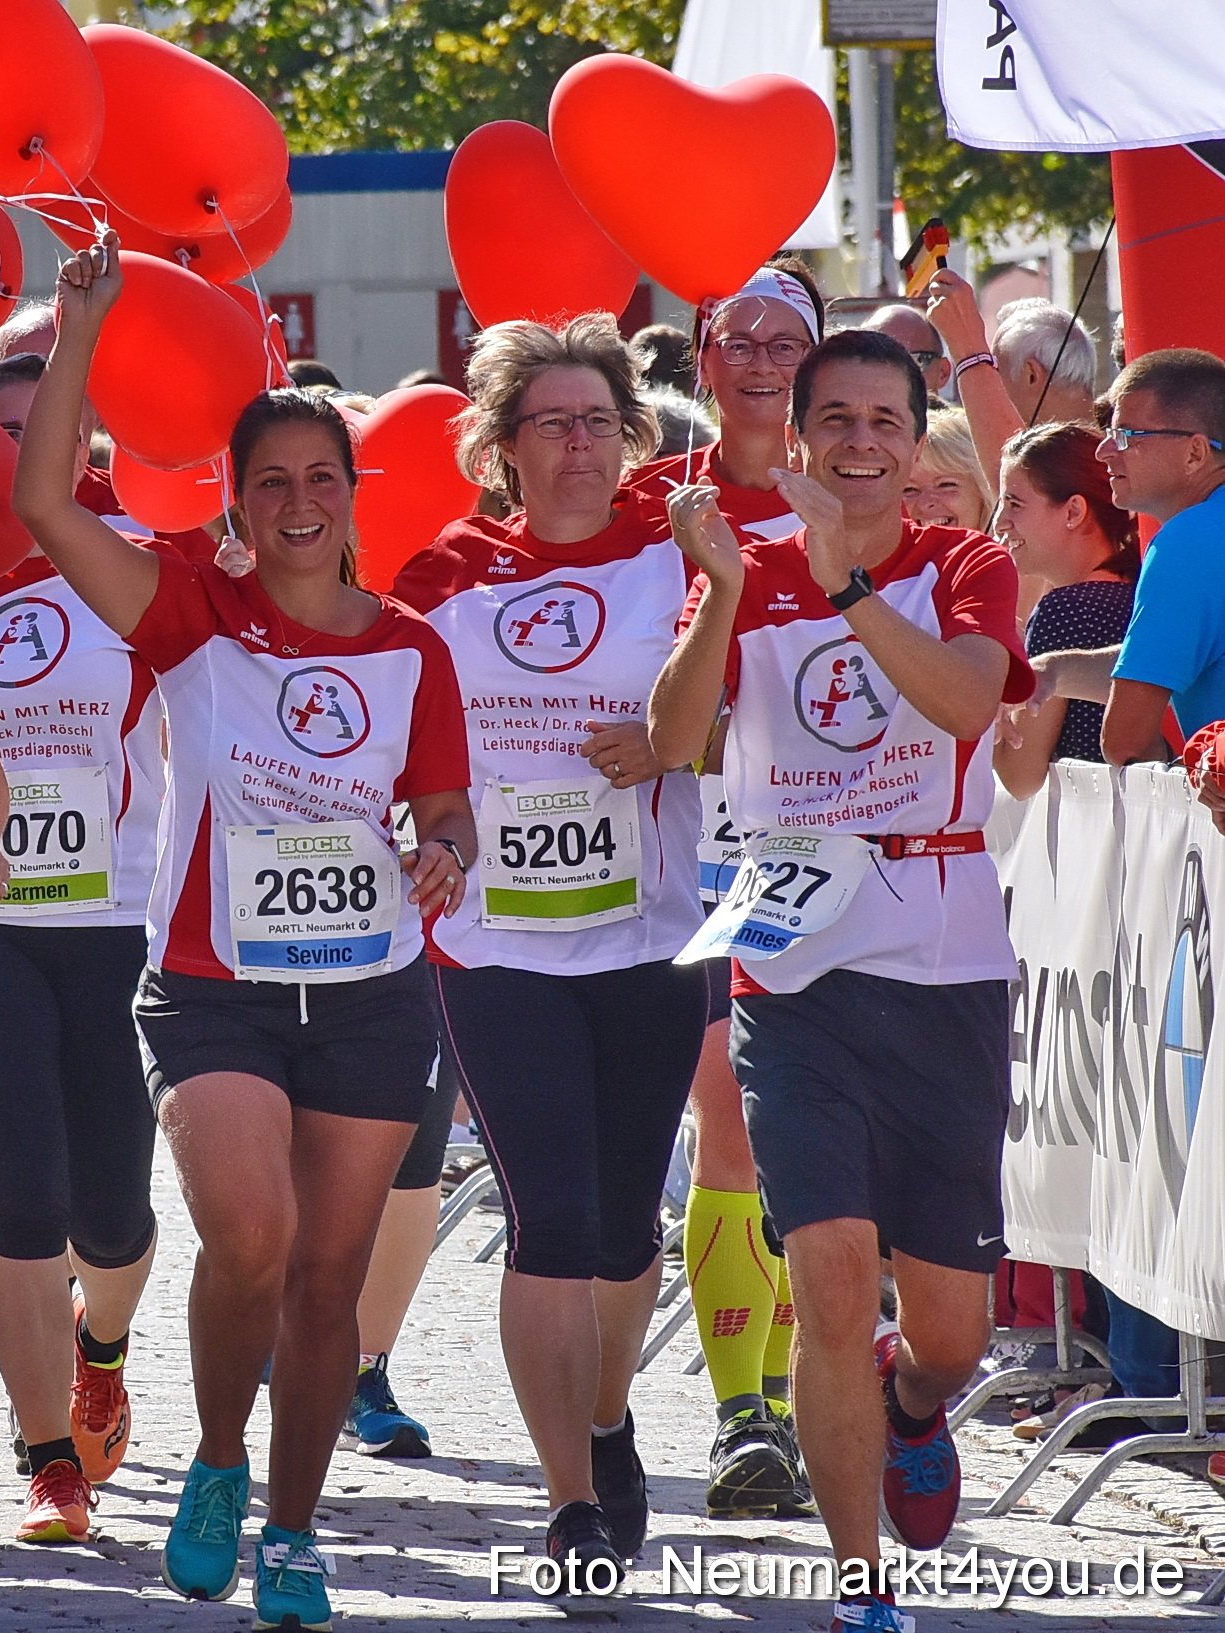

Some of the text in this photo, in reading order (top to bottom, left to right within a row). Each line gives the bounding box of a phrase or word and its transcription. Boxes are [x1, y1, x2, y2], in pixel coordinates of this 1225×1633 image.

[487, 565, 516, 575] erima
[767, 602, 799, 611] erima
[240, 629, 270, 649] erima
[15, 705, 49, 719] MIT
[58, 699, 110, 716] HERZ
[543, 697, 579, 709] MIT
[589, 694, 641, 715] HERZ
[27, 725, 46, 736] Dr.
[50, 724, 93, 737] Röschl
[480, 719, 500, 730] Dr.
[504, 717, 539, 729] Heck
[553, 719, 570, 731] Dr.
[483, 736, 582, 756] Leistungsdiagn
[230, 743, 384, 804] LAUFEN MIT HERZ
[770, 765, 842, 787] LAUFEN
[883, 740, 935, 767] HERZ
[243, 773, 261, 786] Dr.
[265, 777, 296, 797] Heck
[309, 794, 326, 808] Dr.
[869, 770, 919, 792] Röschl
[517, 790, 591, 813] BOCK
[778, 790, 919, 827] Leistungsdiagnostik
[0, 810, 86, 857] 070
[500, 816, 616, 869] 5204
[277, 835, 353, 854] BOCK
[760, 836, 823, 853] BOCK
[20, 862, 65, 872] Neumarkt
[512, 873, 596, 885] PARTL Neumarkt
[255, 864, 377, 917] 2638
[750, 908, 787, 922] umarkt
[268, 921, 355, 934] PARTL Neumarkt
[287, 944, 353, 965] Sevinc
